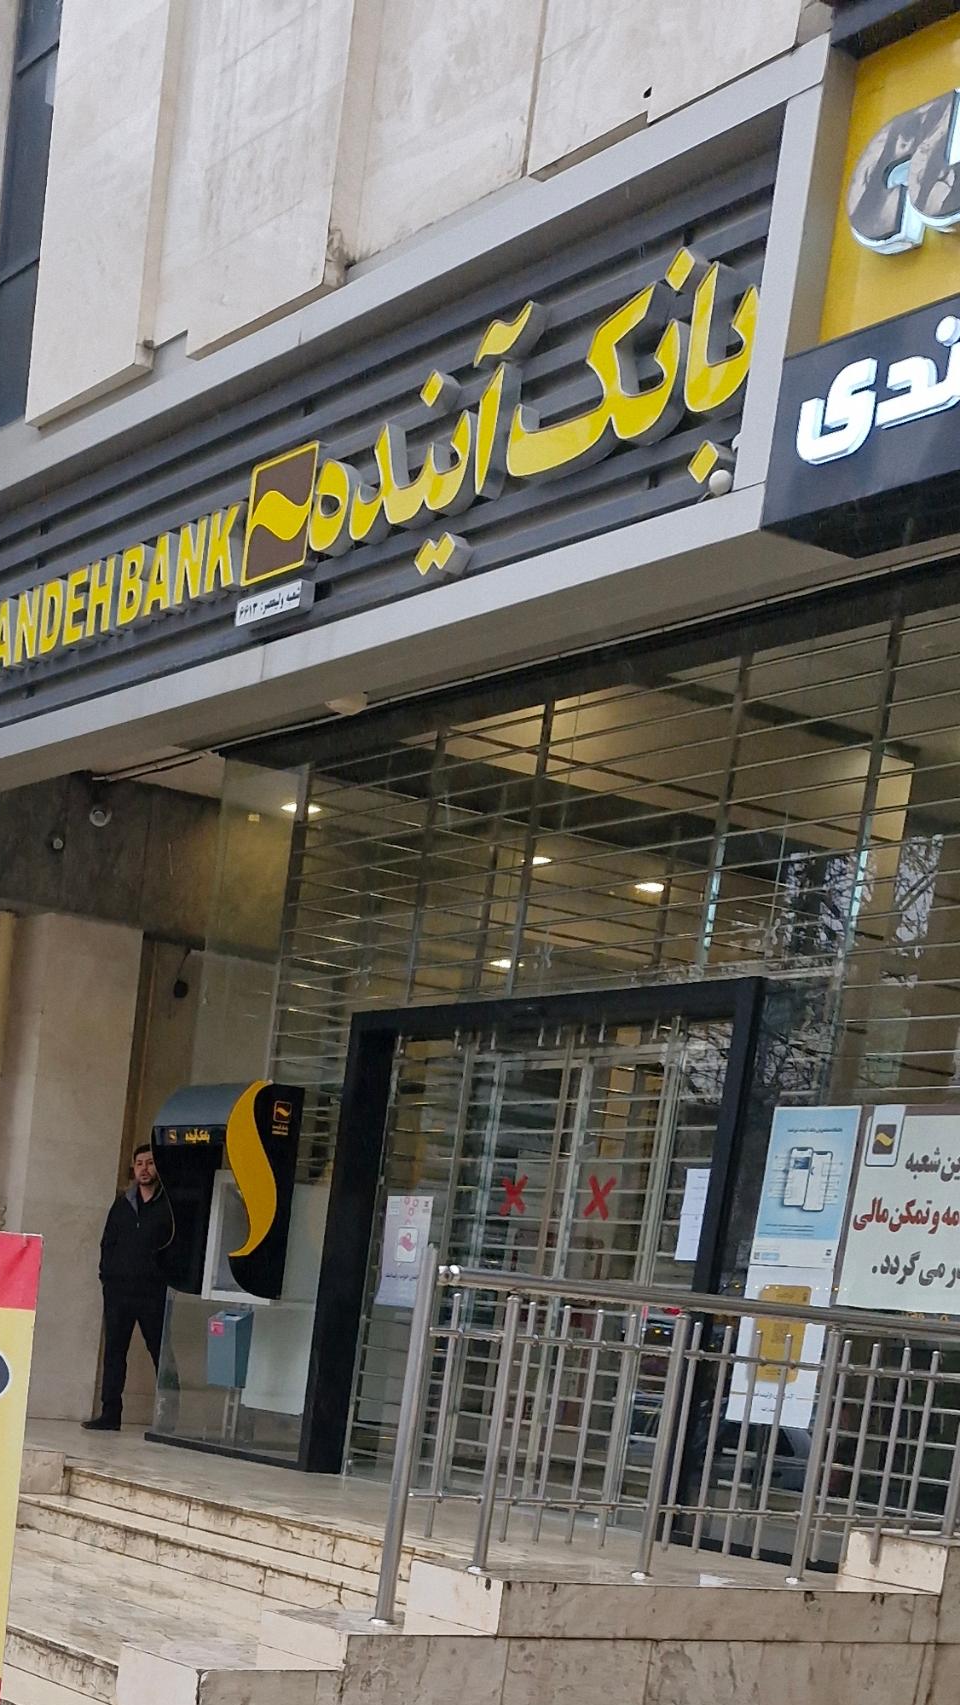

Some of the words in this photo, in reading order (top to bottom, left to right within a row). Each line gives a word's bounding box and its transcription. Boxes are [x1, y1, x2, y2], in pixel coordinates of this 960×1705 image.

[507, 247, 759, 483] بانک
[309, 301, 536, 577] آینده
[905, 1146, 941, 1180] شعبه
[853, 1196, 889, 1231] مالی
[889, 1199, 933, 1232] تمکن
[928, 1210, 940, 1234] و
[919, 1263, 946, 1287] می
